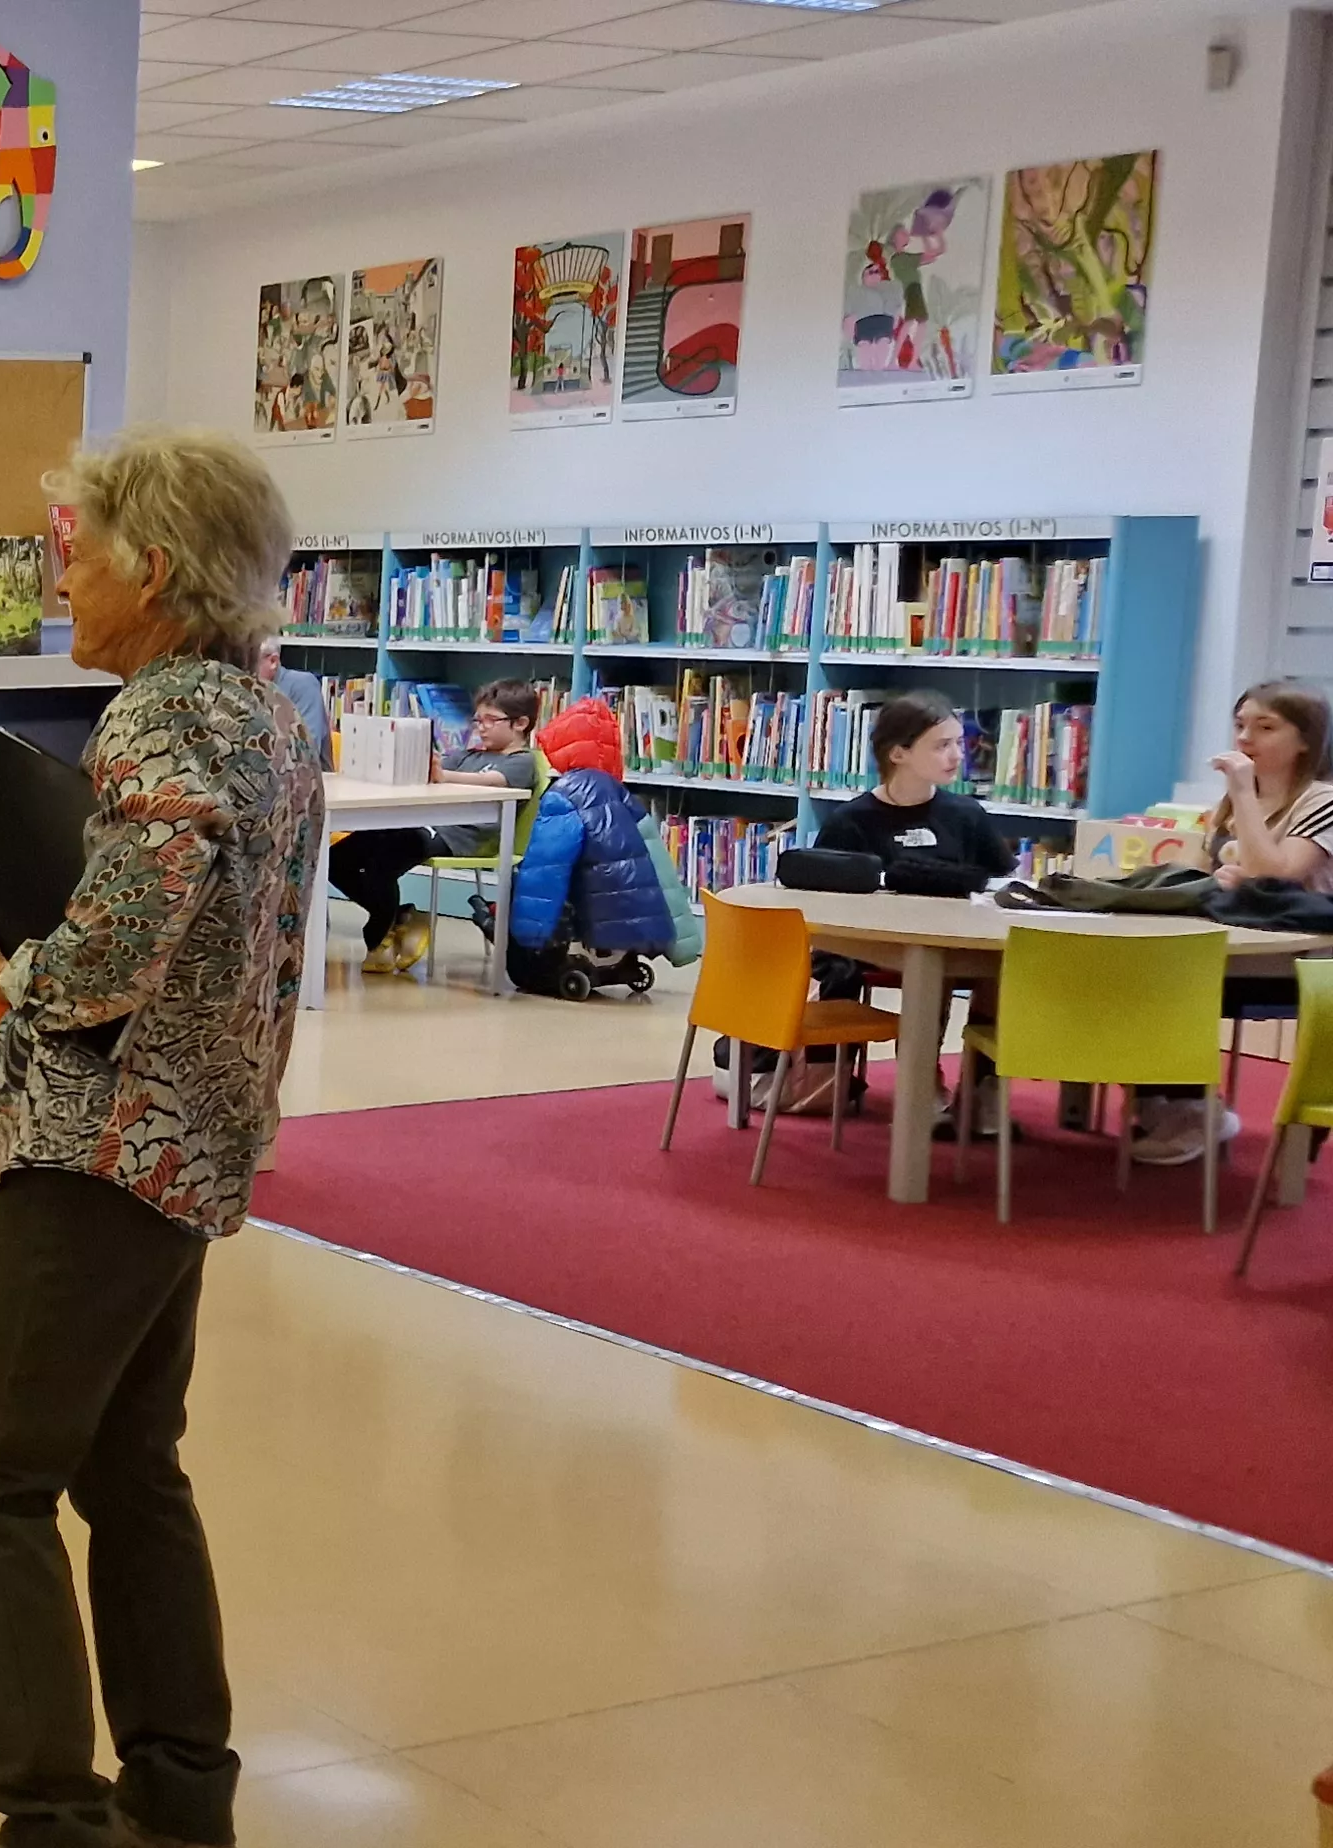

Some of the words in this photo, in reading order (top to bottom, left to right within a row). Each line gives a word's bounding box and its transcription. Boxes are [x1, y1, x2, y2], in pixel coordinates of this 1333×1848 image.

[625, 527, 730, 542] INFORMATIVOS
[871, 520, 1003, 537] INFORMATIVOS
[422, 531, 512, 545] INFORMATIVOS
